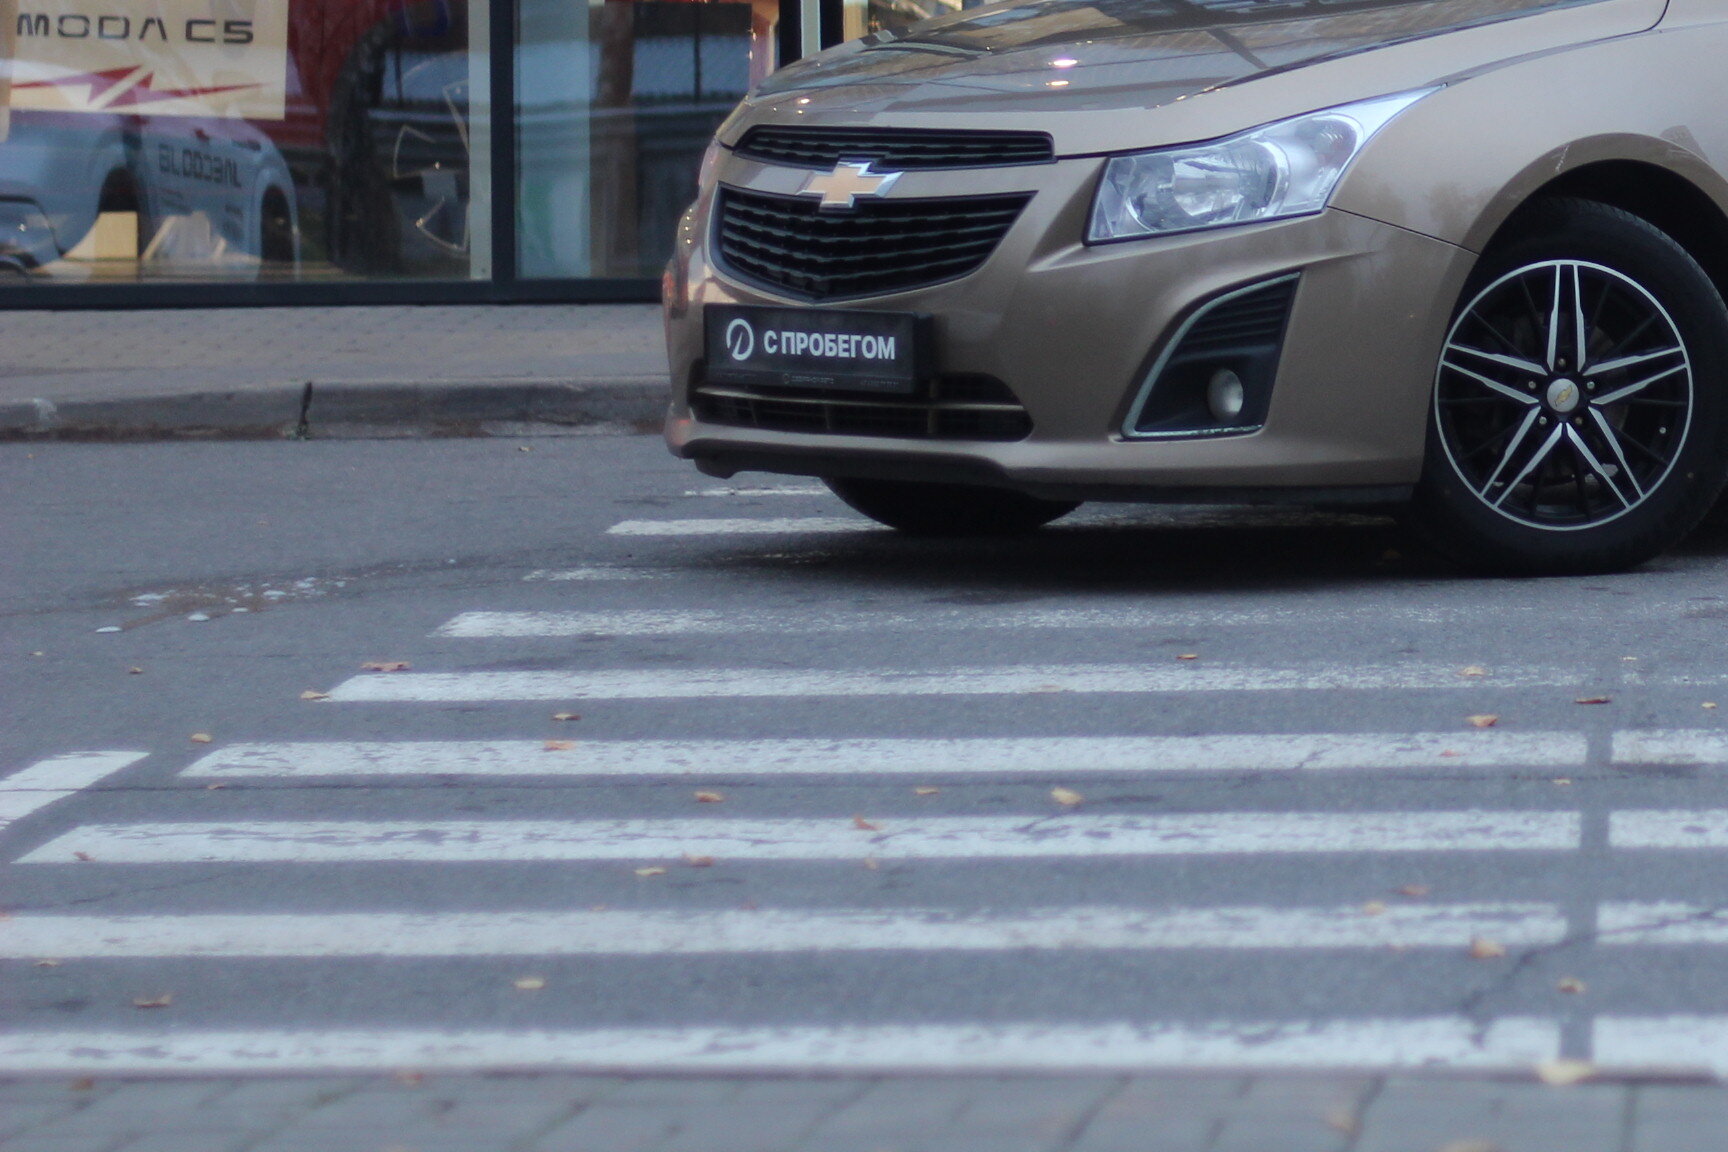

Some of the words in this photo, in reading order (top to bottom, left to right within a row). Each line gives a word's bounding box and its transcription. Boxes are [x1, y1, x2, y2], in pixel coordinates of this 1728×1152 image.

[185, 19, 254, 45] C5
[763, 330, 778, 354] С
[781, 331, 896, 361] ПРОБЕГОМ
